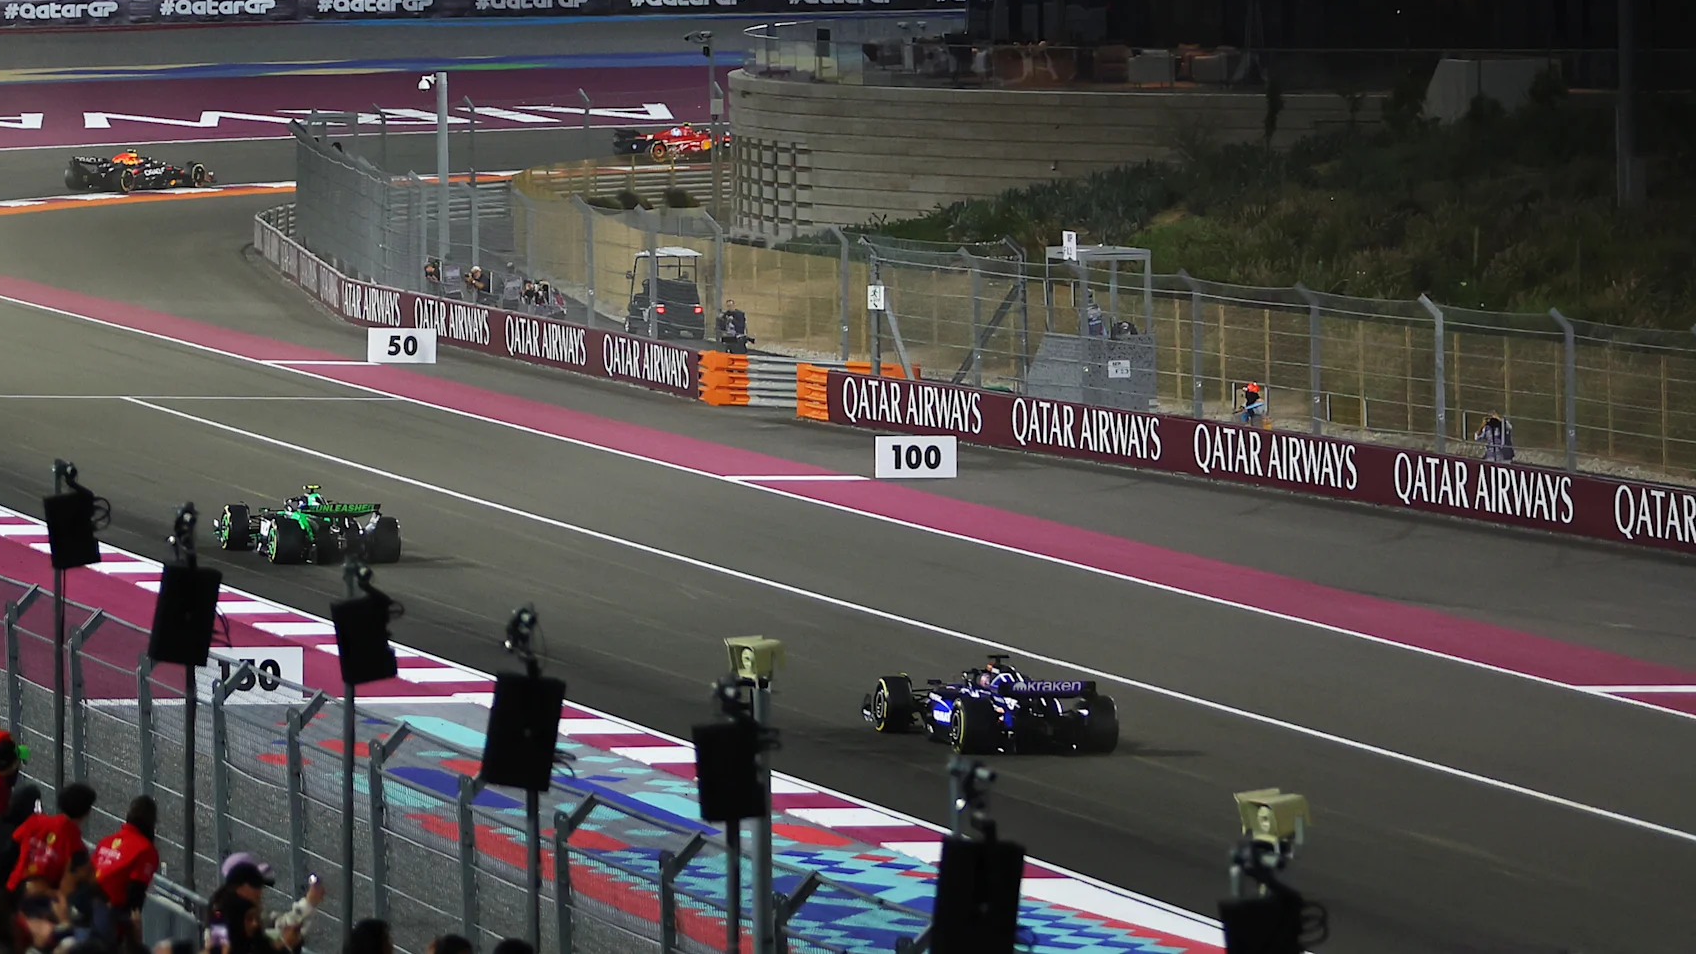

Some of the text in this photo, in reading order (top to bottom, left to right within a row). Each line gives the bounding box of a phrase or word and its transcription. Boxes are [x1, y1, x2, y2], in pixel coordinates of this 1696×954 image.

[362, 286, 401, 327] AIRWAYS
[448, 303, 490, 346] AIRWAYS
[388, 336, 418, 357] 50
[505, 315, 586, 366] QATAR AIRWAYS
[603, 333, 691, 390] QATAR AIRWAYS
[842, 375, 983, 435] QATAR AIRWAYS
[1010, 396, 1162, 461] QATAR AIRWAYS
[892, 445, 942, 470] 100
[1193, 422, 1358, 491] QATAR AIRWAYS
[1393, 451, 1575, 526] QATAR AIRWAYS
[1614, 484, 1696, 544] QATAR
[1027, 681, 1082, 692] kraken
